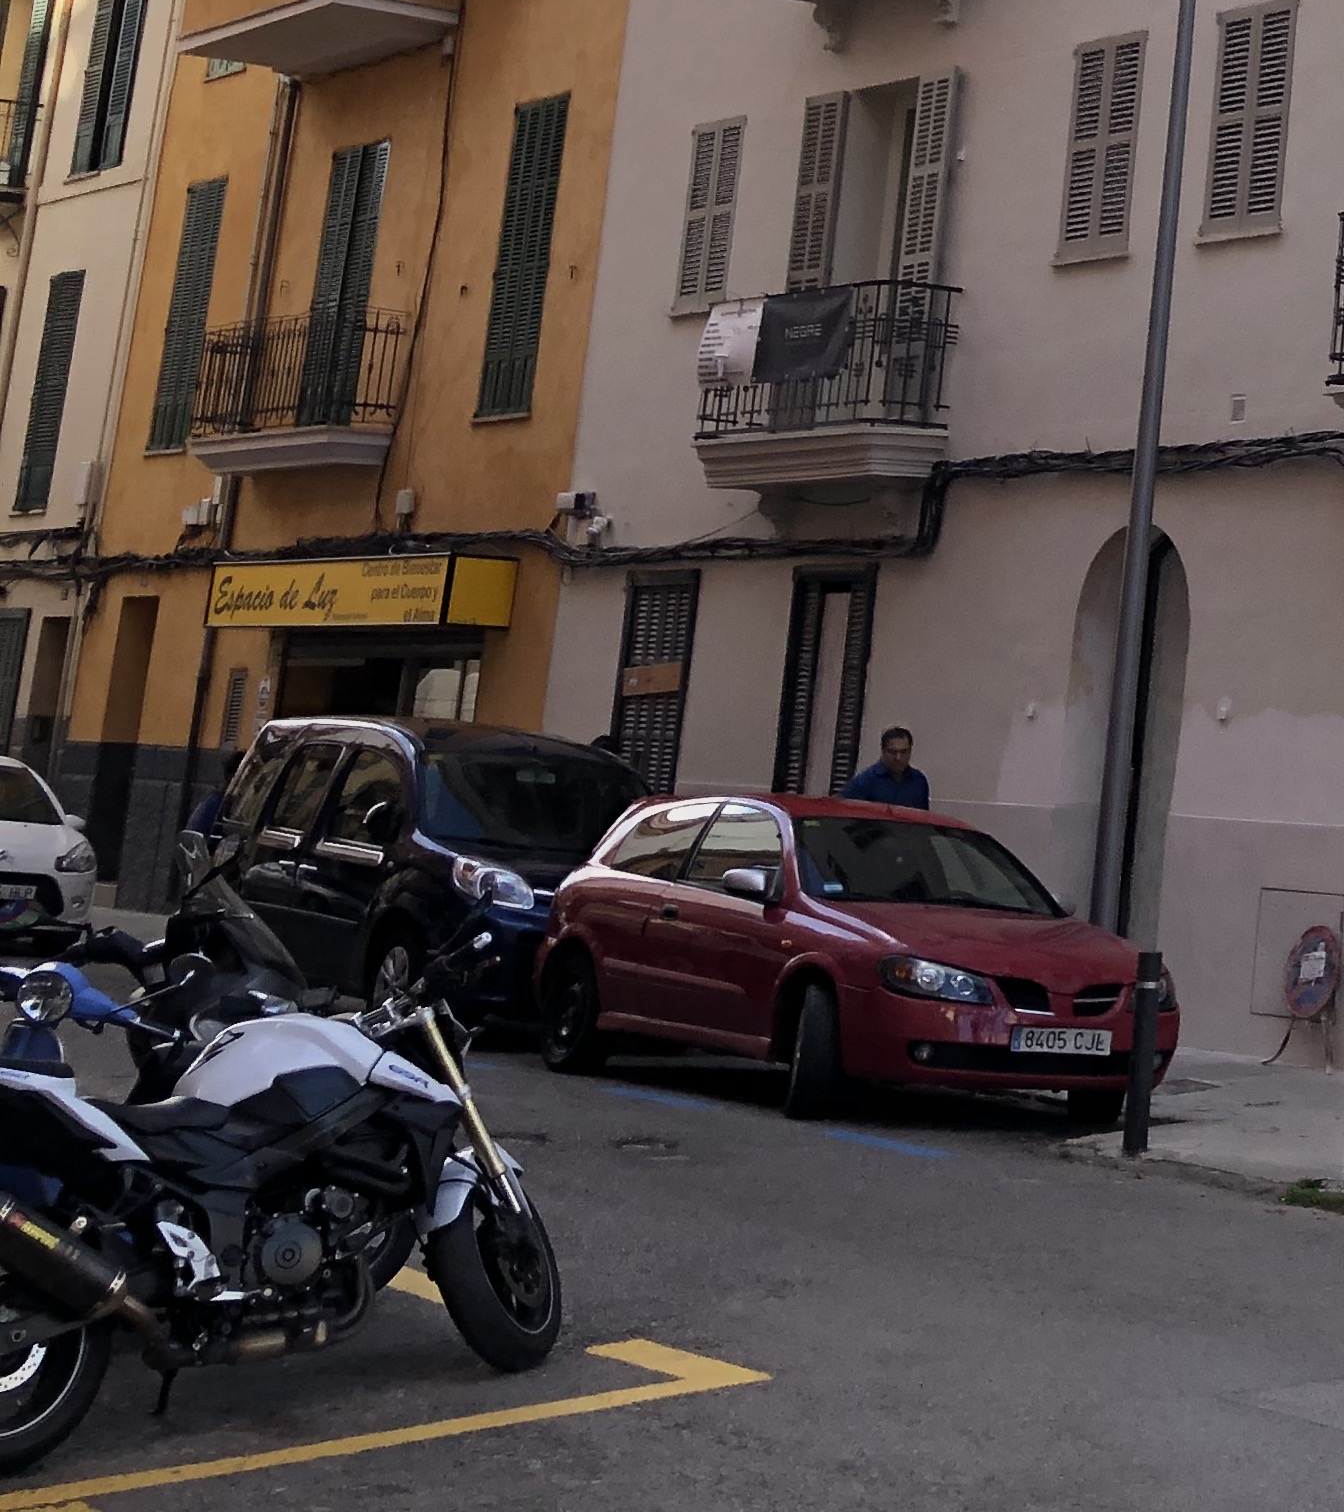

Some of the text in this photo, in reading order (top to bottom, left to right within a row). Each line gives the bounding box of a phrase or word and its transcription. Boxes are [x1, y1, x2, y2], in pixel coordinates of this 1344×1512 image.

[785, 324, 822, 339] NEGRE
[214, 572, 338, 622] Espacio de Luz
[1025, 1030, 1105, 1051] 8405 CJL
